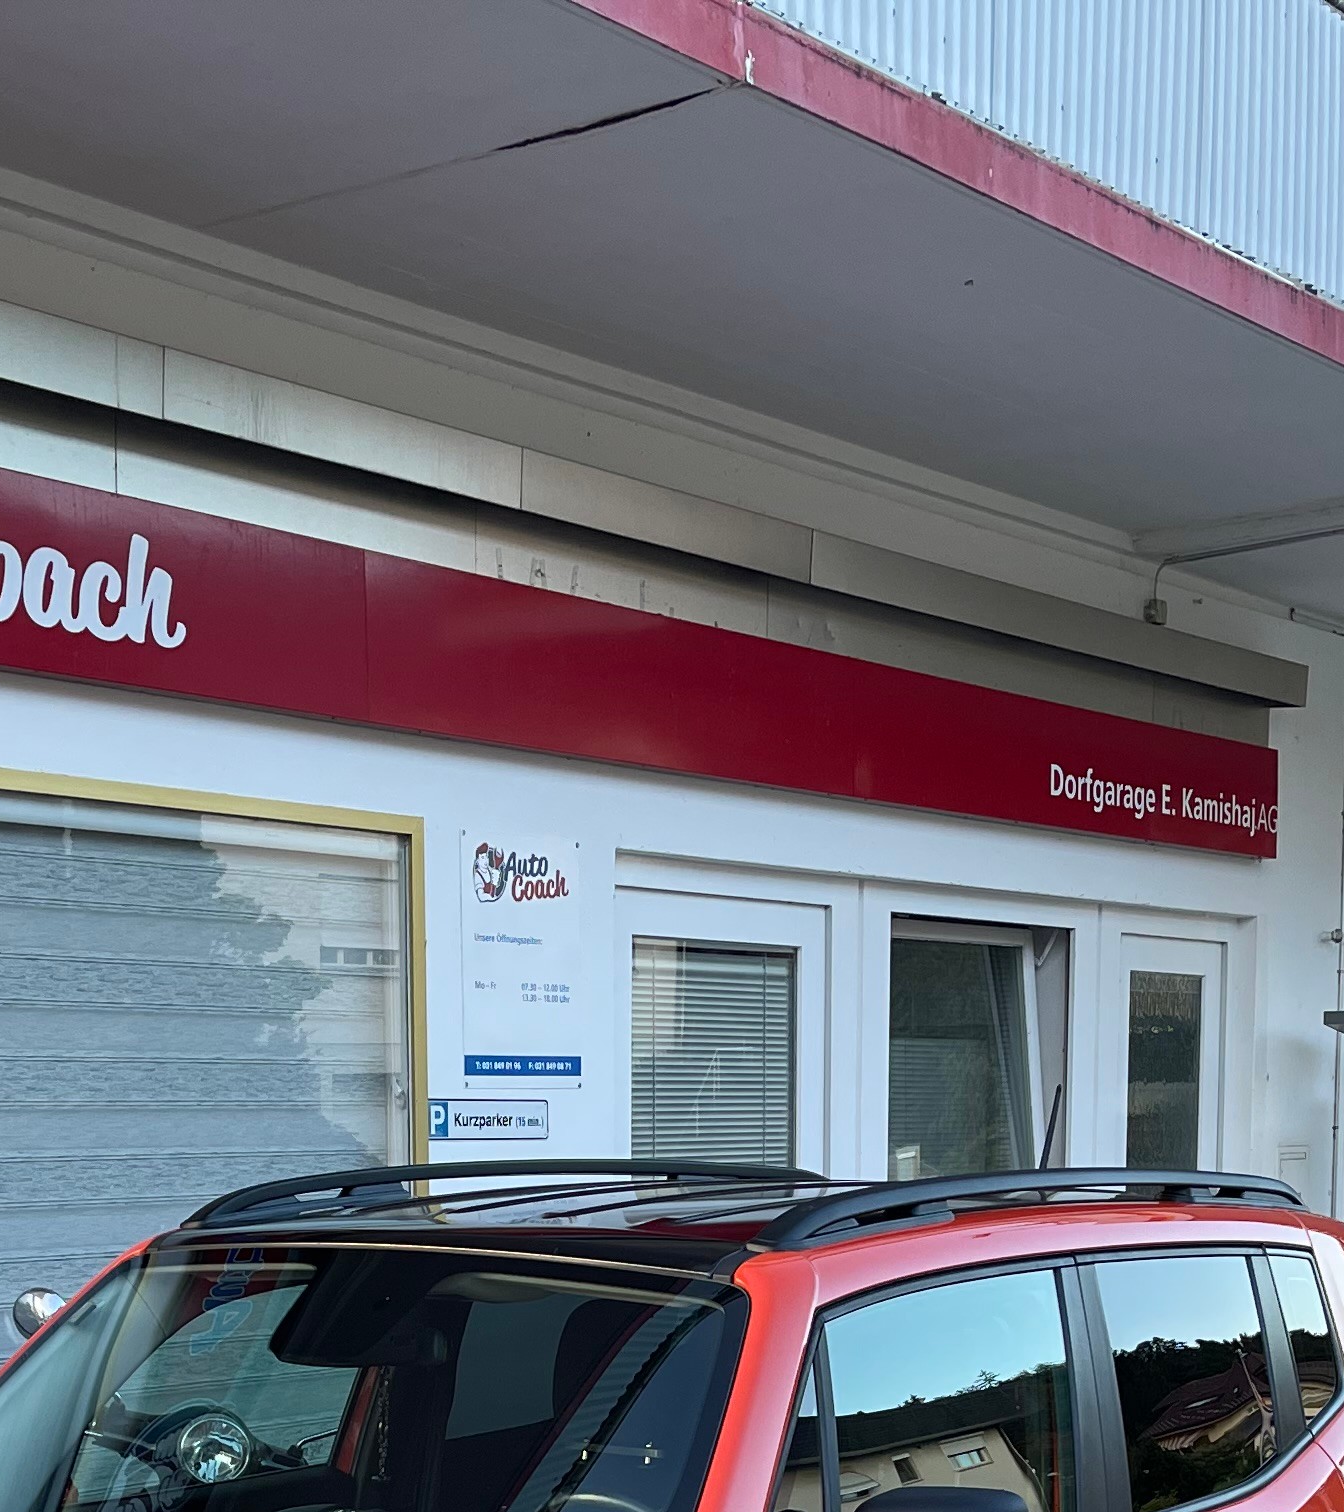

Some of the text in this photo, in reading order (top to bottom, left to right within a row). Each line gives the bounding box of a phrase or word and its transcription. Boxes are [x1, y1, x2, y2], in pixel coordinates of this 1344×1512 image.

[1050, 763, 1155, 819] Dorfgarage
[1162, 784, 1176, 816] E.
[1182, 787, 1256, 837] Kamishaj
[504, 851, 548, 878] Auto
[511, 870, 569, 902] Coach
[474, 933, 495, 942] Unsere
[454, 1112, 513, 1130] Kurzparker
